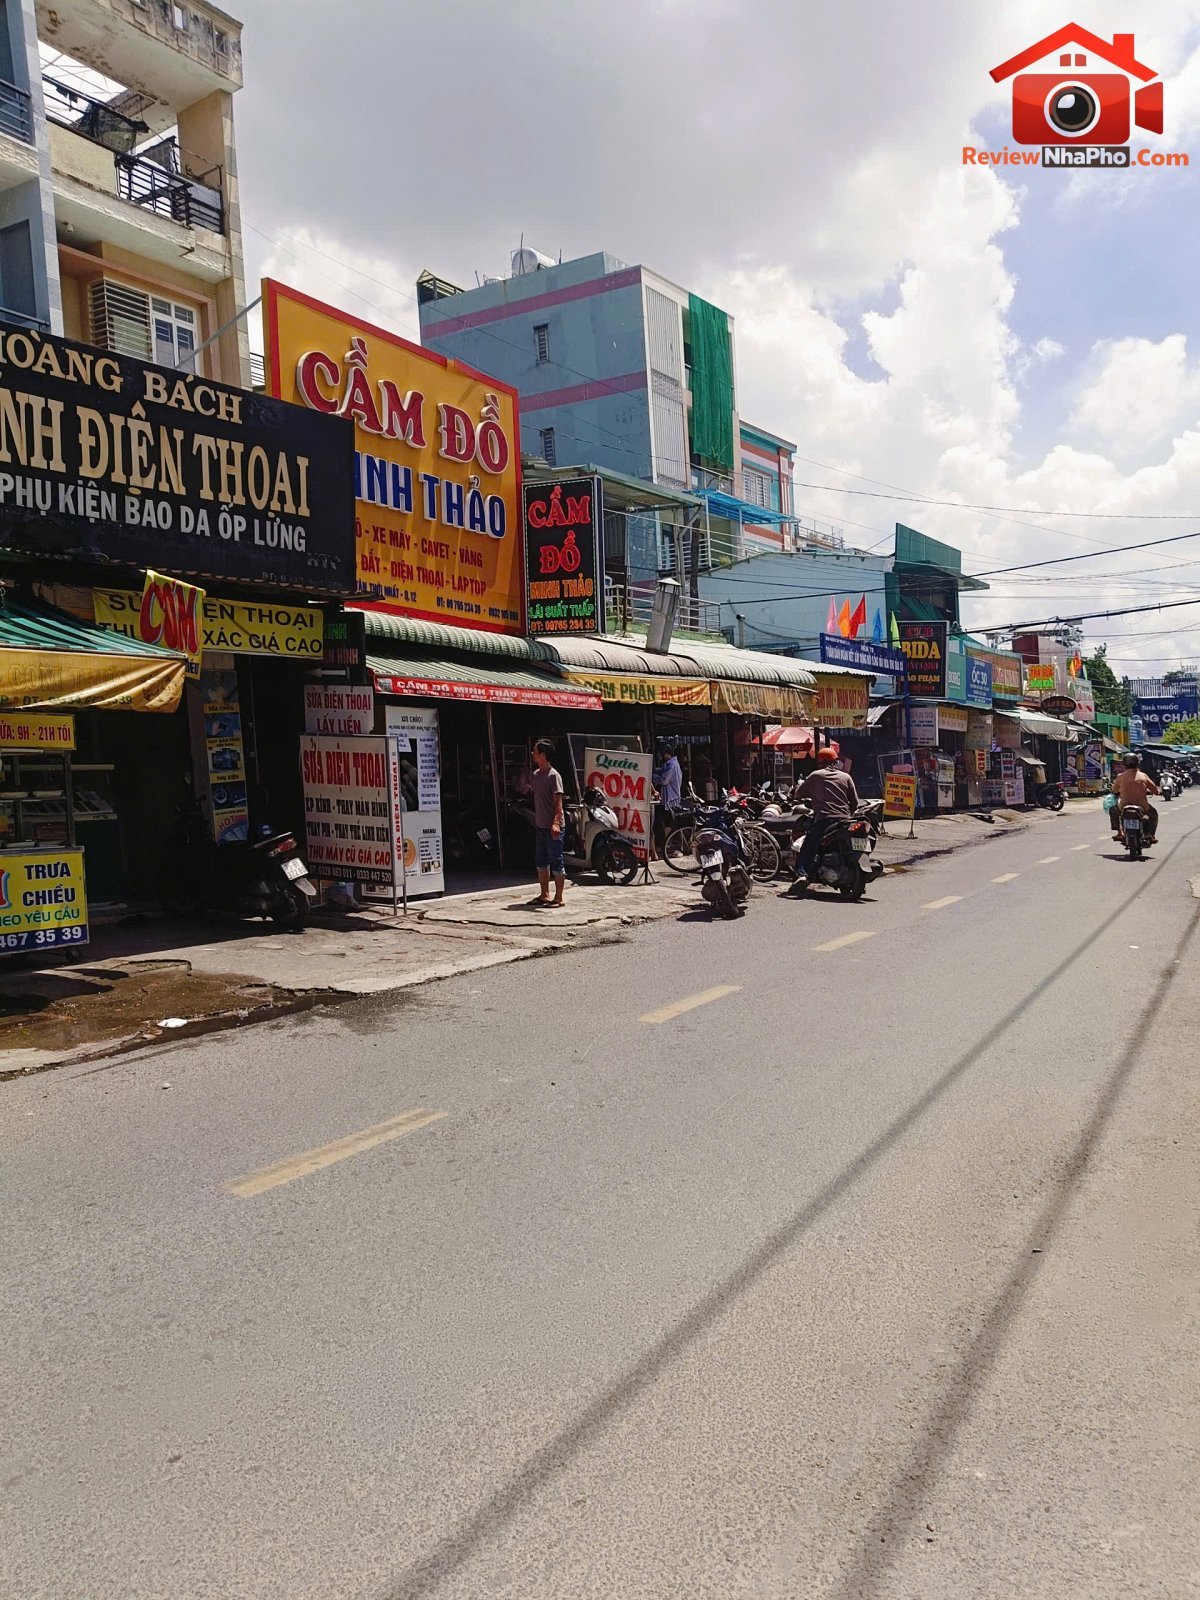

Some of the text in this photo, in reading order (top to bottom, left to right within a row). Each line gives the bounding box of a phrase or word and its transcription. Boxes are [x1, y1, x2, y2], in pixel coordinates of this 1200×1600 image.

[143, 370, 243, 424] BÁCH
[296, 336, 509, 474] CẦM ĐỒ
[76, 400, 186, 495] ĐIỆN
[192, 433, 310, 518] THOẠI
[0, 472, 52, 516] PHỤ
[125, 495, 172, 530] BAO
[180, 505, 211, 537] DA
[218, 502, 247, 541] ỐP
[419, 475, 506, 538] THẢO
[372, 525, 386, 544] XE
[389, 530, 411, 550] MÁY
[421, 538, 450, 560] CAVET
[459, 545, 483, 568] VÀNG
[361, 548, 380, 574] ĐẤT
[391, 559, 413, 584] ĐIỆN
[416, 567, 444, 592] THOẠI
[452, 574, 487, 597] LAPTOP
[243, 606, 314, 631] THOẠI
[545, 600, 568, 618] SUẤT
[569, 598, 594, 617] THẤP
[203, 627, 322, 654] XÁC GIÁ CAO
[901, 641, 941, 659] BIDA
[306, 688, 371, 714] SỬA ĐIỆN THOẠI
[18, 726, 29, 740] 9H
[38, 726, 55, 741] 21H
[58, 722, 71, 742] TỐI
[317, 713, 335, 733] LẤY
[303, 738, 324, 784] SỬA
[326, 742, 350, 794] ĐIỆN
[352, 751, 387, 797] THOẠI
[595, 754, 640, 771] Quán
[336, 799, 353, 815] THAY
[308, 845, 324, 860] THU
[325, 843, 344, 862] MÁY
[358, 846, 372, 864] GIÁ
[374, 851, 391, 866] CAO
[24, 861, 71, 880] TRƯA
[371, 871, 381, 881] 447
[381, 872, 392, 882] 520
[23, 884, 76, 907] CHIỀU
[25, 910, 51, 924] YÊU
[54, 906, 80, 921] CẦU
[35, 929, 56, 943] 35
[62, 926, 82, 940] 39
